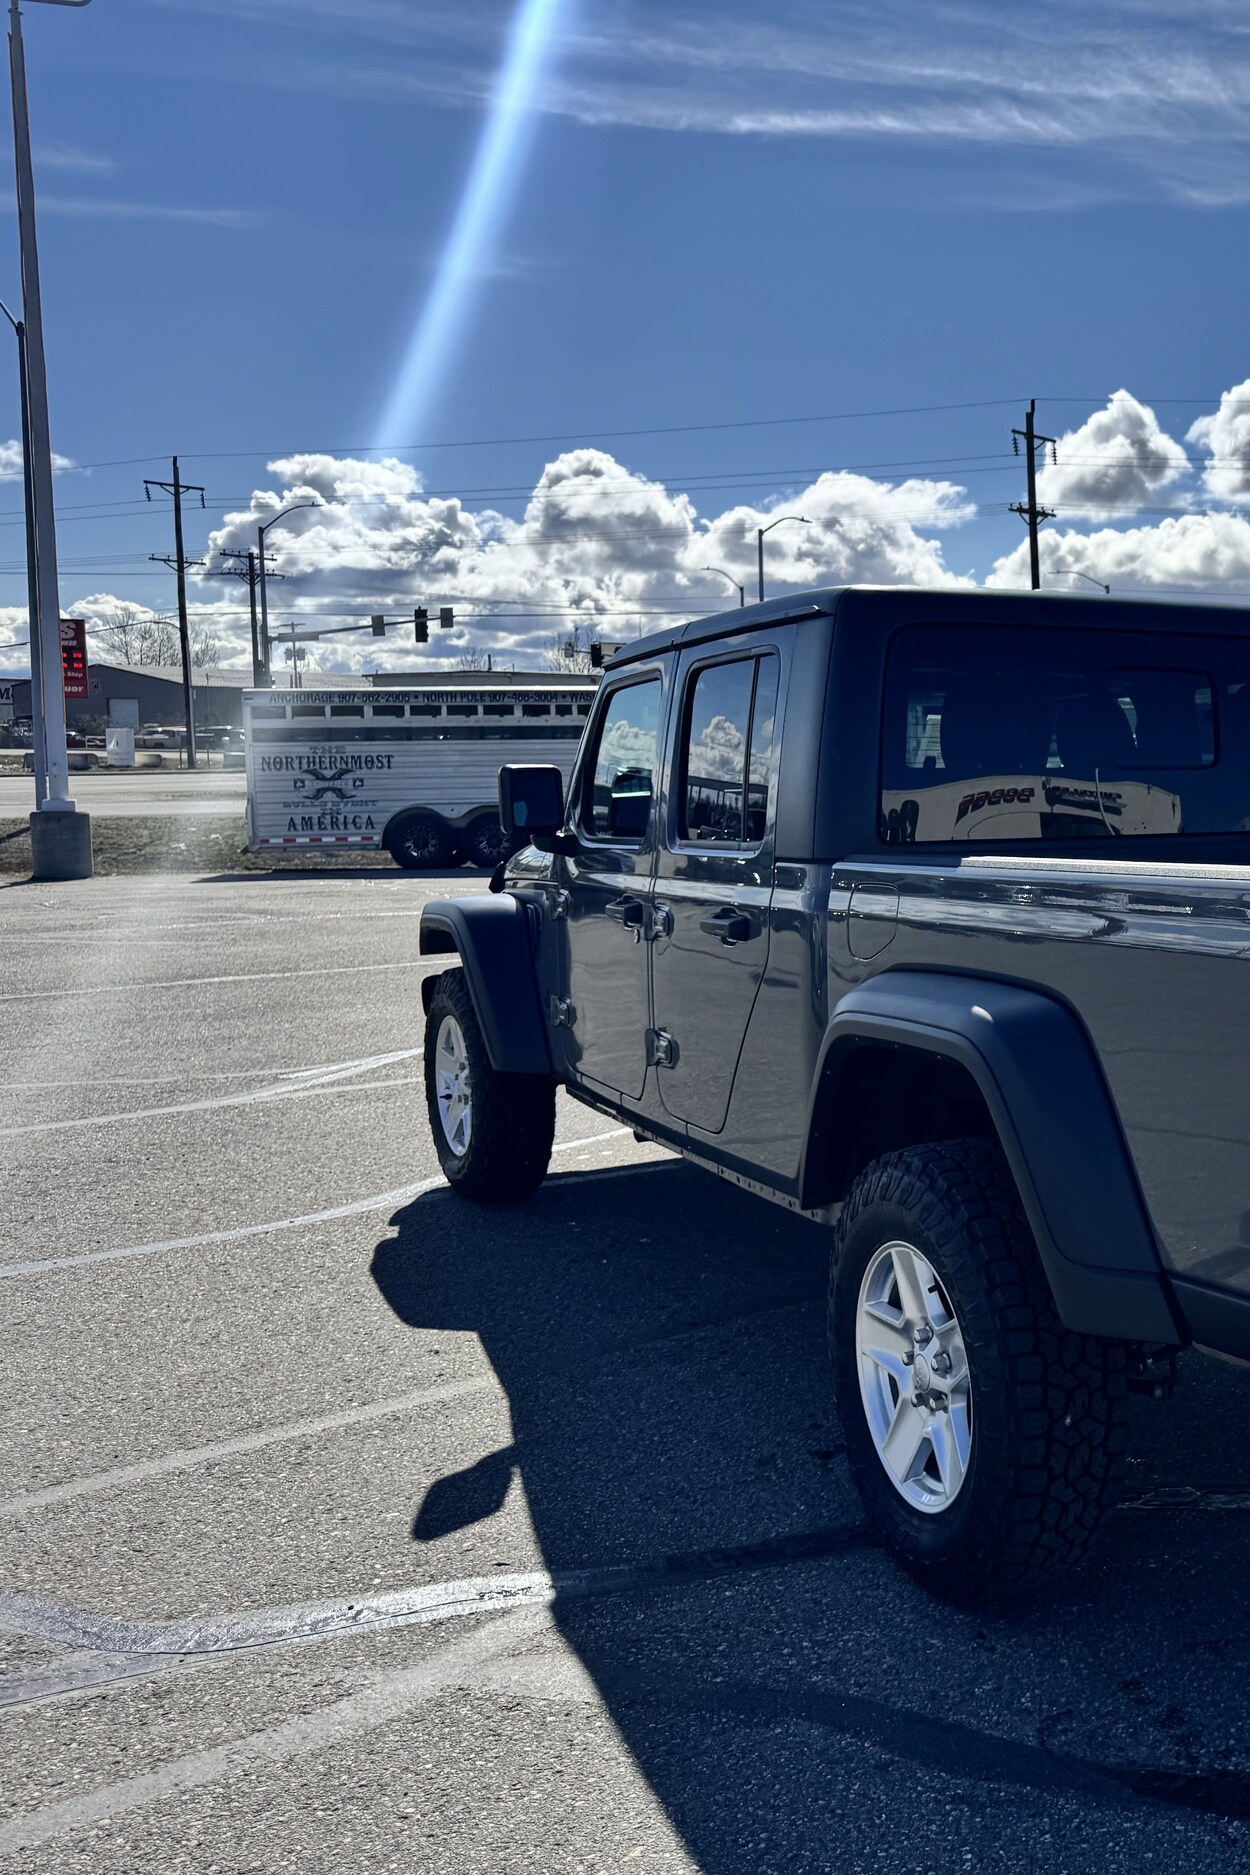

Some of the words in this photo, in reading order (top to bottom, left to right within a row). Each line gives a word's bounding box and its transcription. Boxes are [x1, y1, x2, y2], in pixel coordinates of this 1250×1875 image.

[269, 692, 335, 704] ANCHORAGE
[422, 691, 458, 703] NORTH
[460, 691, 486, 702] POLE
[487, 691, 558, 702] 907-488-3004
[261, 754, 395, 772] NORTHERNMOST
[287, 815, 377, 832] AMERICA
